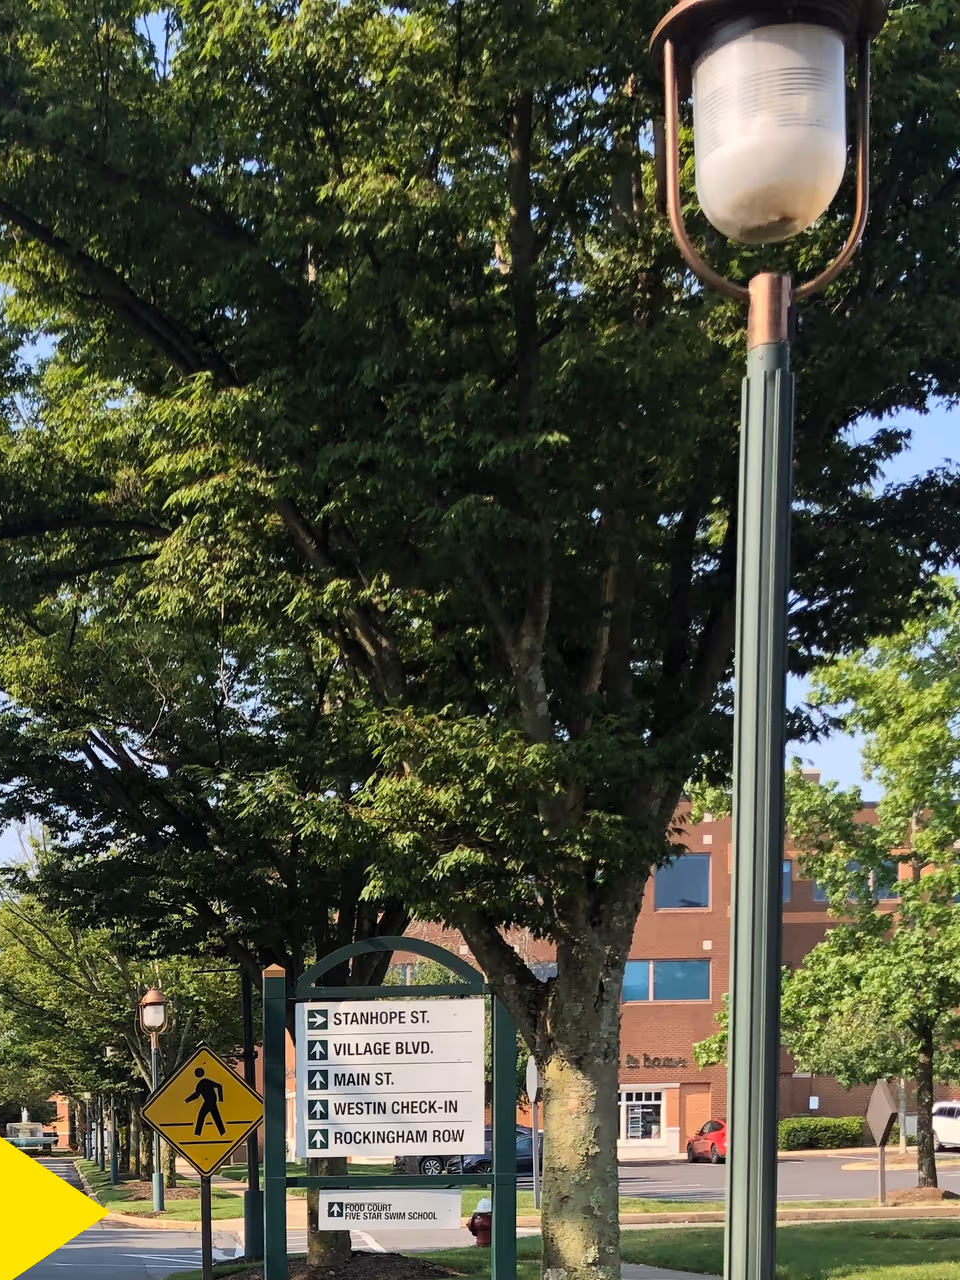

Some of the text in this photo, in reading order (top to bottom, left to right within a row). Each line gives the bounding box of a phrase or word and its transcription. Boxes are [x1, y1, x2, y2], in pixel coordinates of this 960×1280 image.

[333, 1010, 430, 1026] STANHOPE ST.
[333, 1040, 434, 1056] VILLAGE BLVD.
[333, 1072, 395, 1087] MAIN ST.
[333, 1100, 458, 1116] WESTIN CHECK-IN
[333, 1129, 465, 1145] ROCKINGHAM ROW
[345, 1204, 392, 1212] FOOD COURT
[345, 1211, 438, 1220] FIVE STAR SWIM SCHOOL
